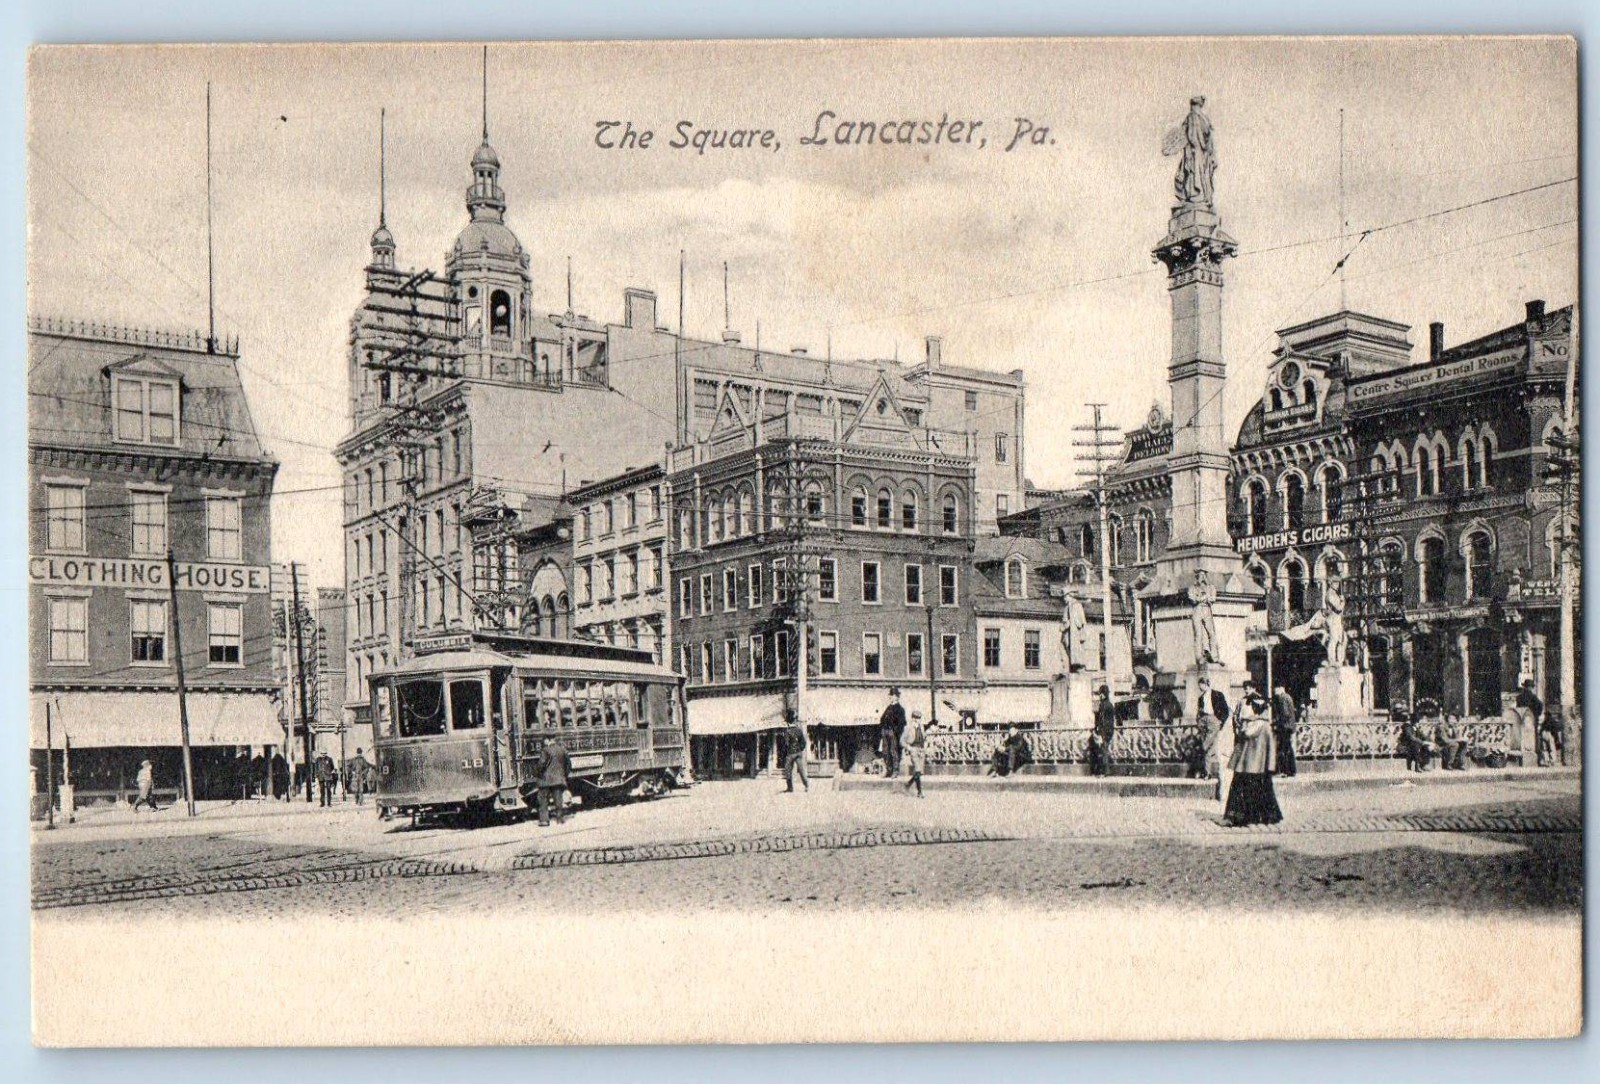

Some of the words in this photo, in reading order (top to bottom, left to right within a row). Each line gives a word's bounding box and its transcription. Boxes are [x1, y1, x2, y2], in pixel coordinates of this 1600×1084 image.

[1354, 382, 1390, 398] Centre
[1394, 373, 1433, 390] Square
[1436, 361, 1474, 379] Dental
[1237, 530, 1298, 553] HENDREN'S
[29, 556, 162, 585] CLOTHING
[173, 564, 268, 590] HOUSE.
